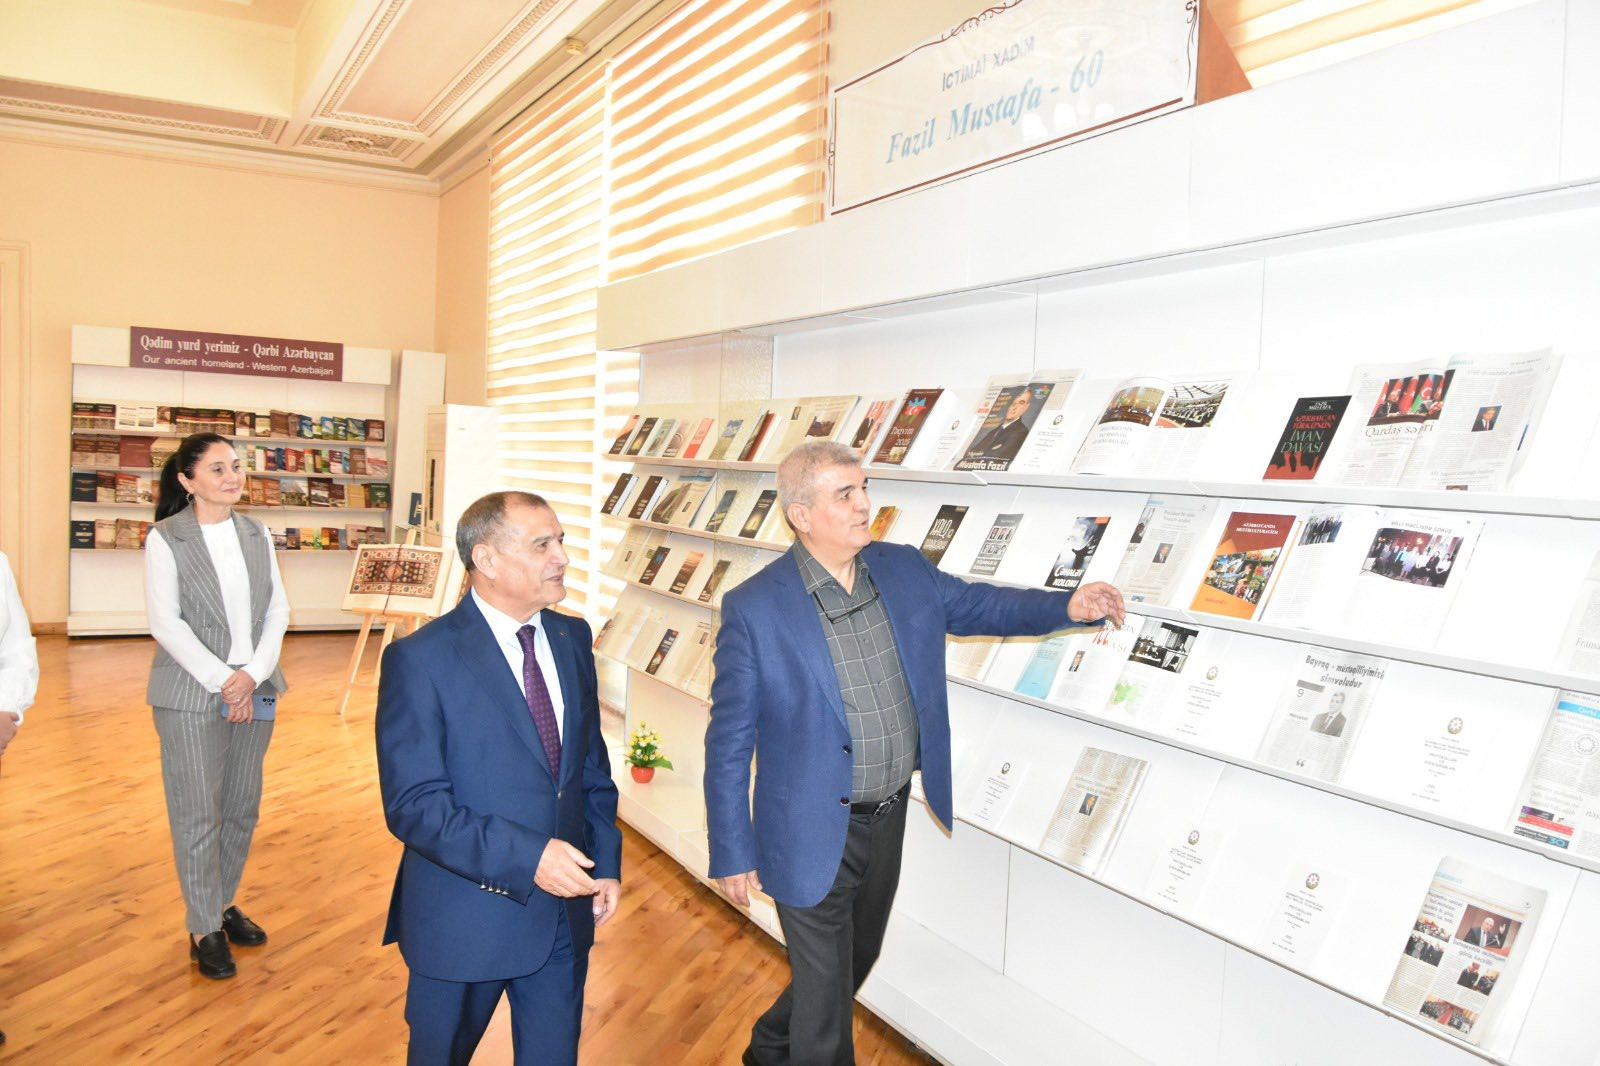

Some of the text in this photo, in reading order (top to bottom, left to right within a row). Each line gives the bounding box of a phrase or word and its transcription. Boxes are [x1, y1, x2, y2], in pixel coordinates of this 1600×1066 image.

[942, 35, 1036, 92] İCTİMAİ XADİM
[886, 119, 936, 164] Fazil
[946, 78, 1043, 140] Mustafa
[1070, 48, 1105, 93] 60
[140, 335, 173, 352] Qədim
[178, 339, 201, 355] yurd
[204, 341, 240, 357] yerimiz
[253, 342, 280, 359] Qərbi
[283, 345, 335, 362] Azərbaycan
[142, 355, 160, 364] Our
[165, 356, 197, 366] ancient
[202, 358, 244, 370] homeland
[252, 362, 287, 373] Western
[290, 365, 335, 376] Azerbaijan
[1305, 655, 1330, 671] Bayraq
